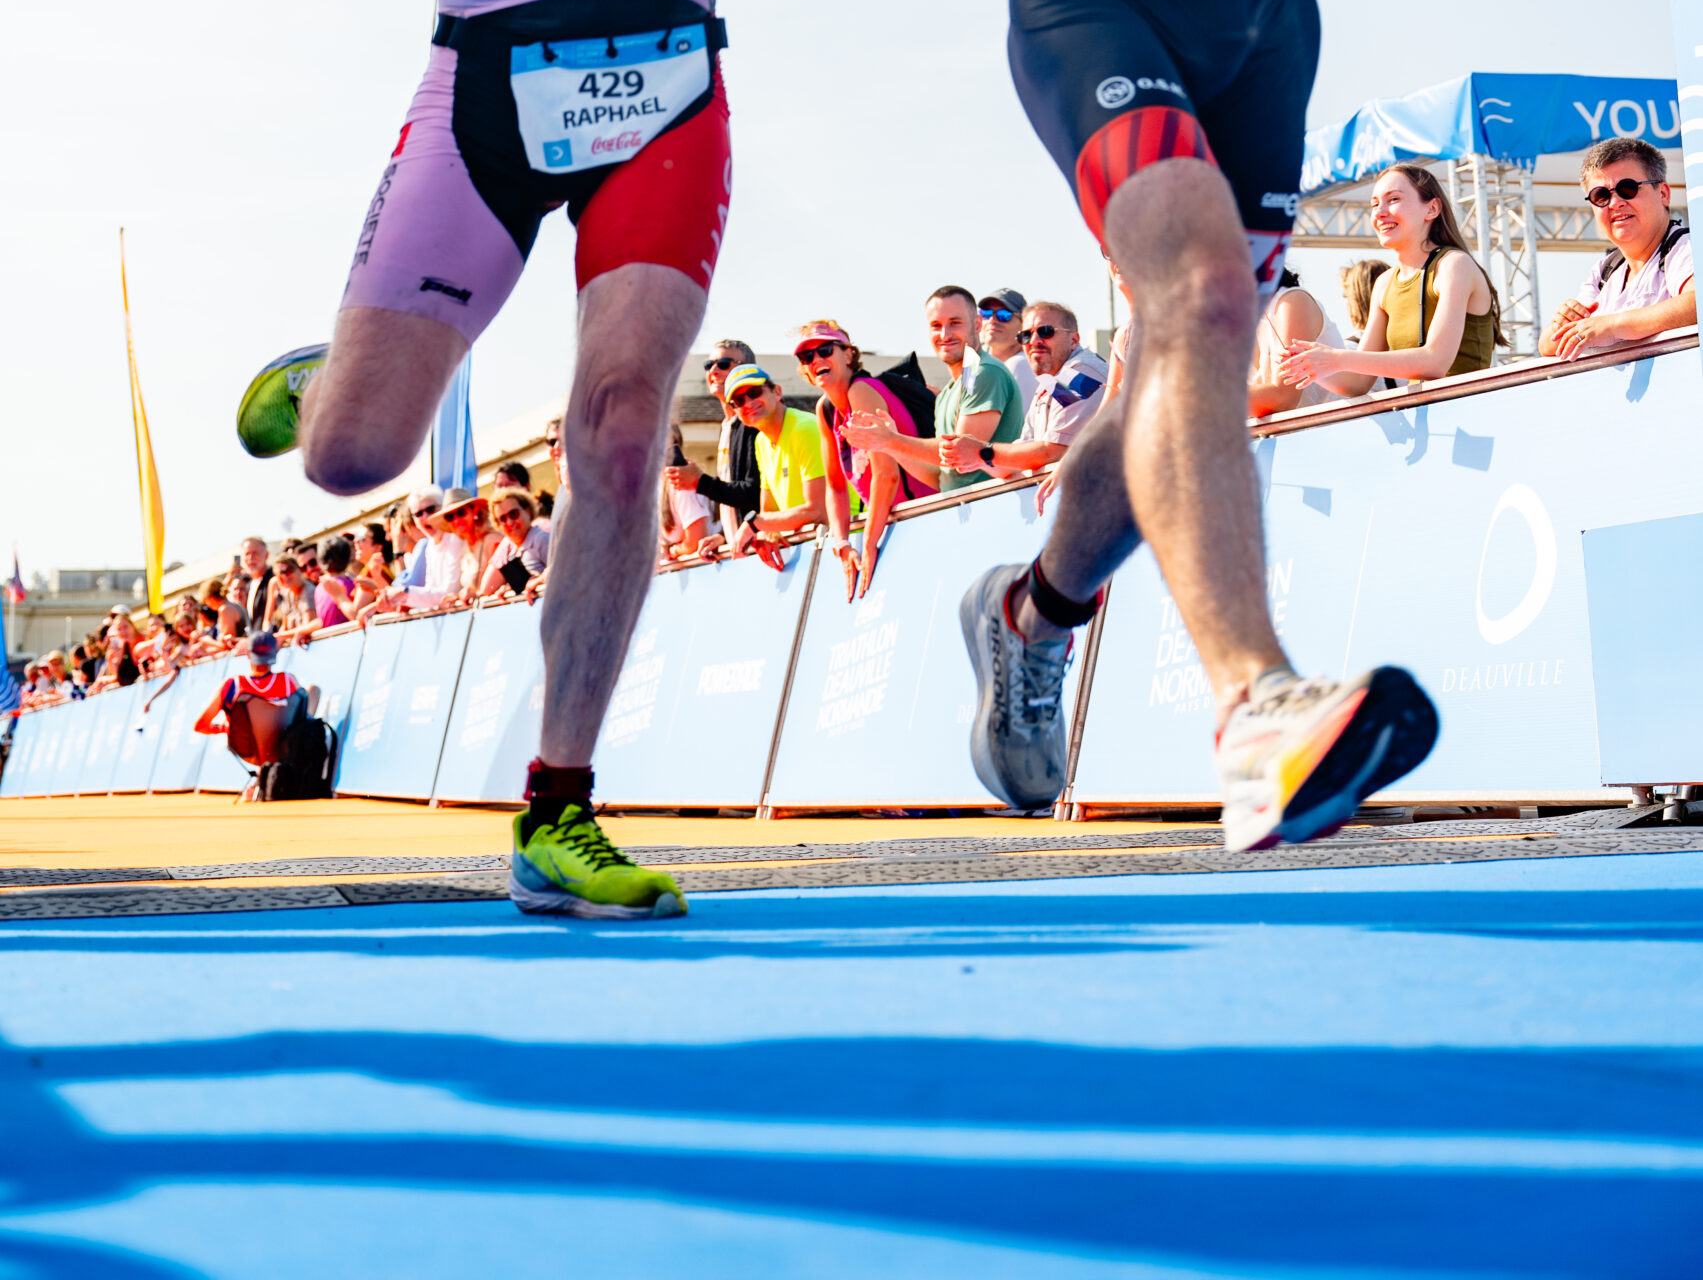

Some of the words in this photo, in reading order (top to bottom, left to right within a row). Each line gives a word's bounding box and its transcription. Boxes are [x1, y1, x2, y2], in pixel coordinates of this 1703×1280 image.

[578, 70, 645, 99] 429
[562, 96, 668, 130] RAPHAEL
[1441, 658, 1566, 694] DEAUVILLE
